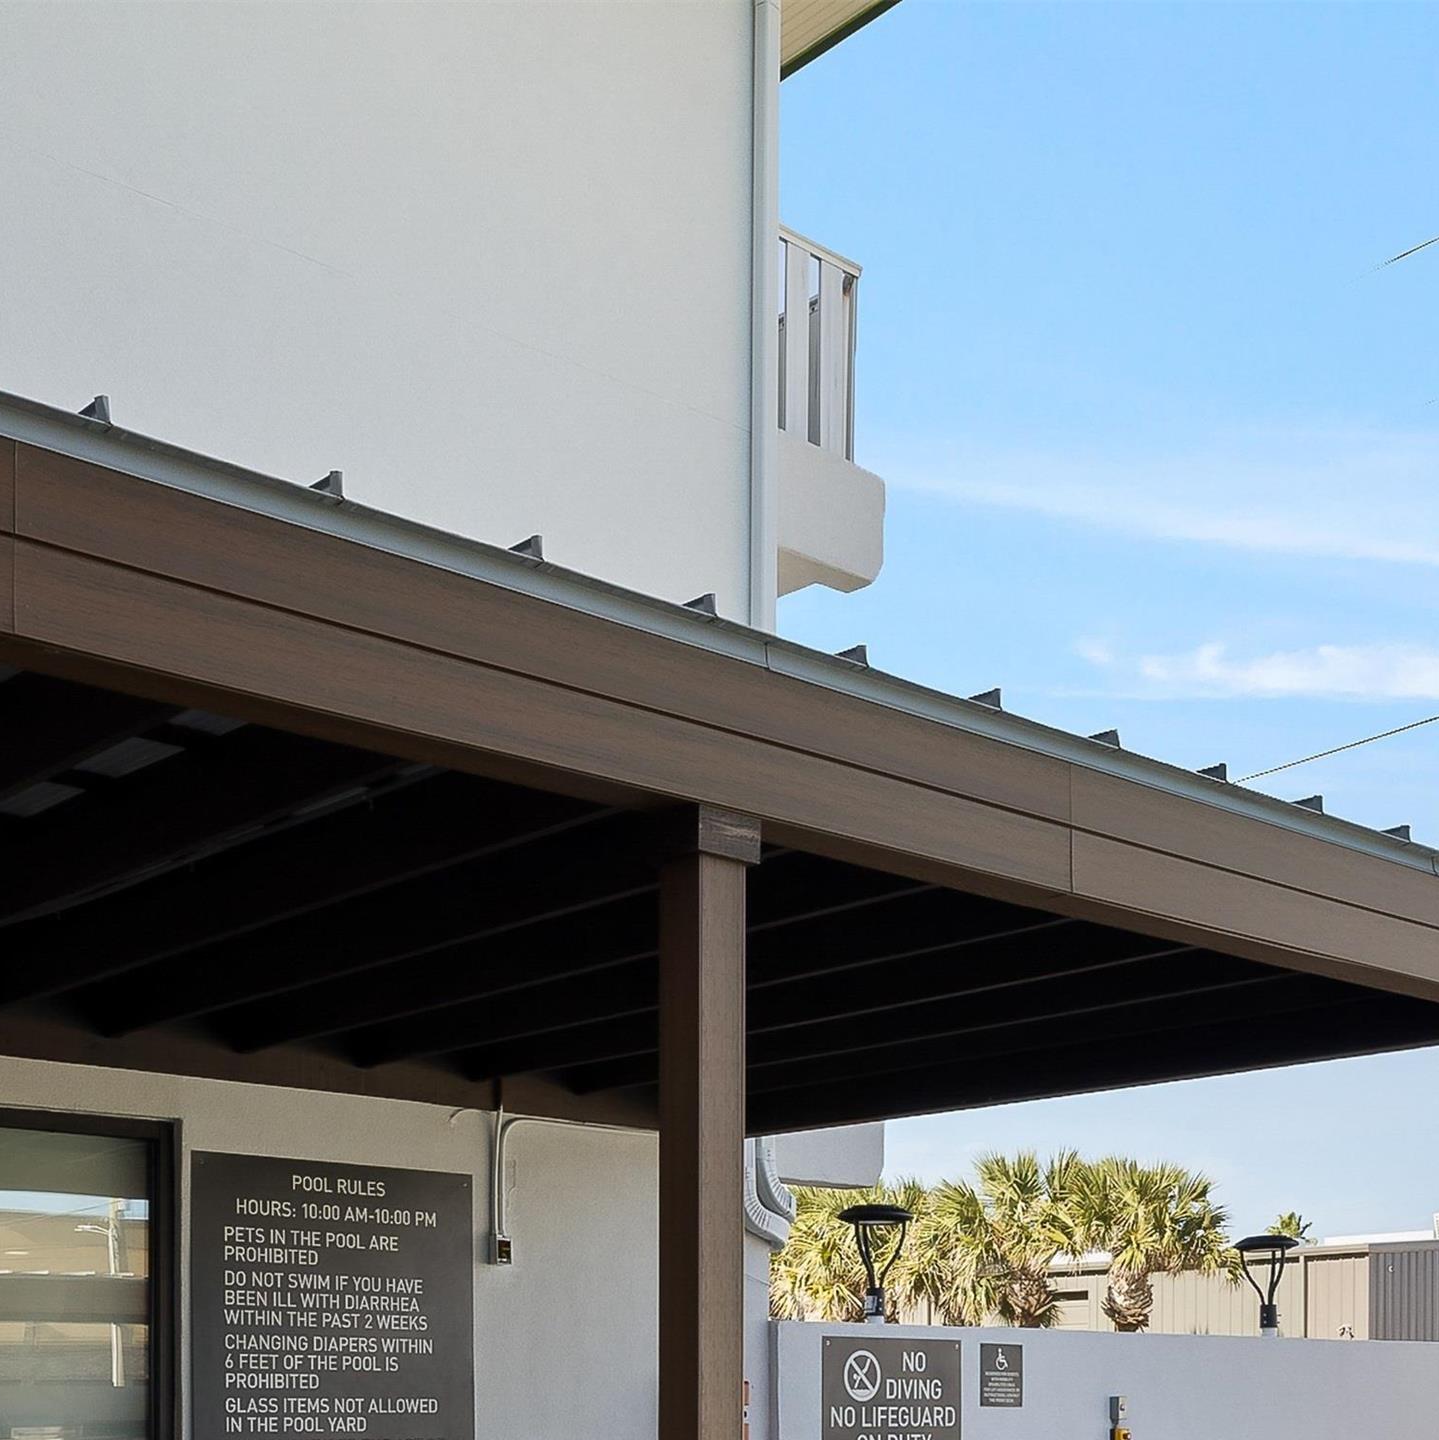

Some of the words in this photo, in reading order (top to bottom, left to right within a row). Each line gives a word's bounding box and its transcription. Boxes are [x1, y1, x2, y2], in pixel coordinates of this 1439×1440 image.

[293, 1175, 332, 1192] POOL
[338, 1179, 385, 1196] RULES
[237, 1198, 295, 1217] HOURS:
[302, 1204, 339, 1220] 10:00
[345, 1207, 410, 1225] AM-10:00
[416, 1212, 436, 1227] PM
[225, 1227, 264, 1243] PETS
[271, 1229, 285, 1244] IN
[291, 1231, 321, 1246] THE
[326, 1233, 365, 1249] POOL
[369, 1236, 398, 1251] ARE
[225, 1246, 318, 1265] PROHIBITED
[225, 1270, 246, 1286] DO
[252, 1272, 284, 1287] NOT
[289, 1274, 329, 1290] SWIM
[336, 1276, 348, 1290] IF
[353, 1276, 381, 1292] YOU
[386, 1278, 423, 1294] HAVE
[225, 1290, 267, 1306] BEEN
[274, 1292, 296, 1307] ILL
[300, 1293, 339, 1309] WITH
[345, 1295, 419, 1312] DIARRHEA
[224, 1309, 281, 1326] WITHIN
[287, 1312, 317, 1327] THE
[323, 1313, 360, 1328] PAST
[365, 1314, 372, 1328] 2
[377, 1315, 427, 1330] WEEKS
[225, 1334, 308, 1351] CHANGING
[314, 1336, 377, 1352] DIAPERS
[382, 1338, 432, 1353] WITHIN
[225, 1354, 233, 1368] 6
[240, 1354, 279, 1369] FEET
[284, 1355, 303, 1369] OF
[308, 1355, 337, 1370] THE
[343, 1356, 381, 1371] POOL
[386, 1357, 398, 1371] IS
[903, 1352, 925, 1371] NO
[226, 1373, 319, 1388] PROHIBITED
[887, 1379, 941, 1399] DIVING
[226, 1398, 278, 1413] GLASS
[284, 1398, 329, 1413] ITEMS
[335, 1398, 364, 1413] NOT
[368, 1399, 437, 1413] ALLOWED
[227, 1417, 241, 1432] IN
[247, 1417, 278, 1432] THE
[284, 1417, 324, 1432] POOL
[328, 1417, 366, 1432] YARD
[831, 1407, 855, 1427] NO
[862, 1407, 955, 1427] LIFEGUARD
